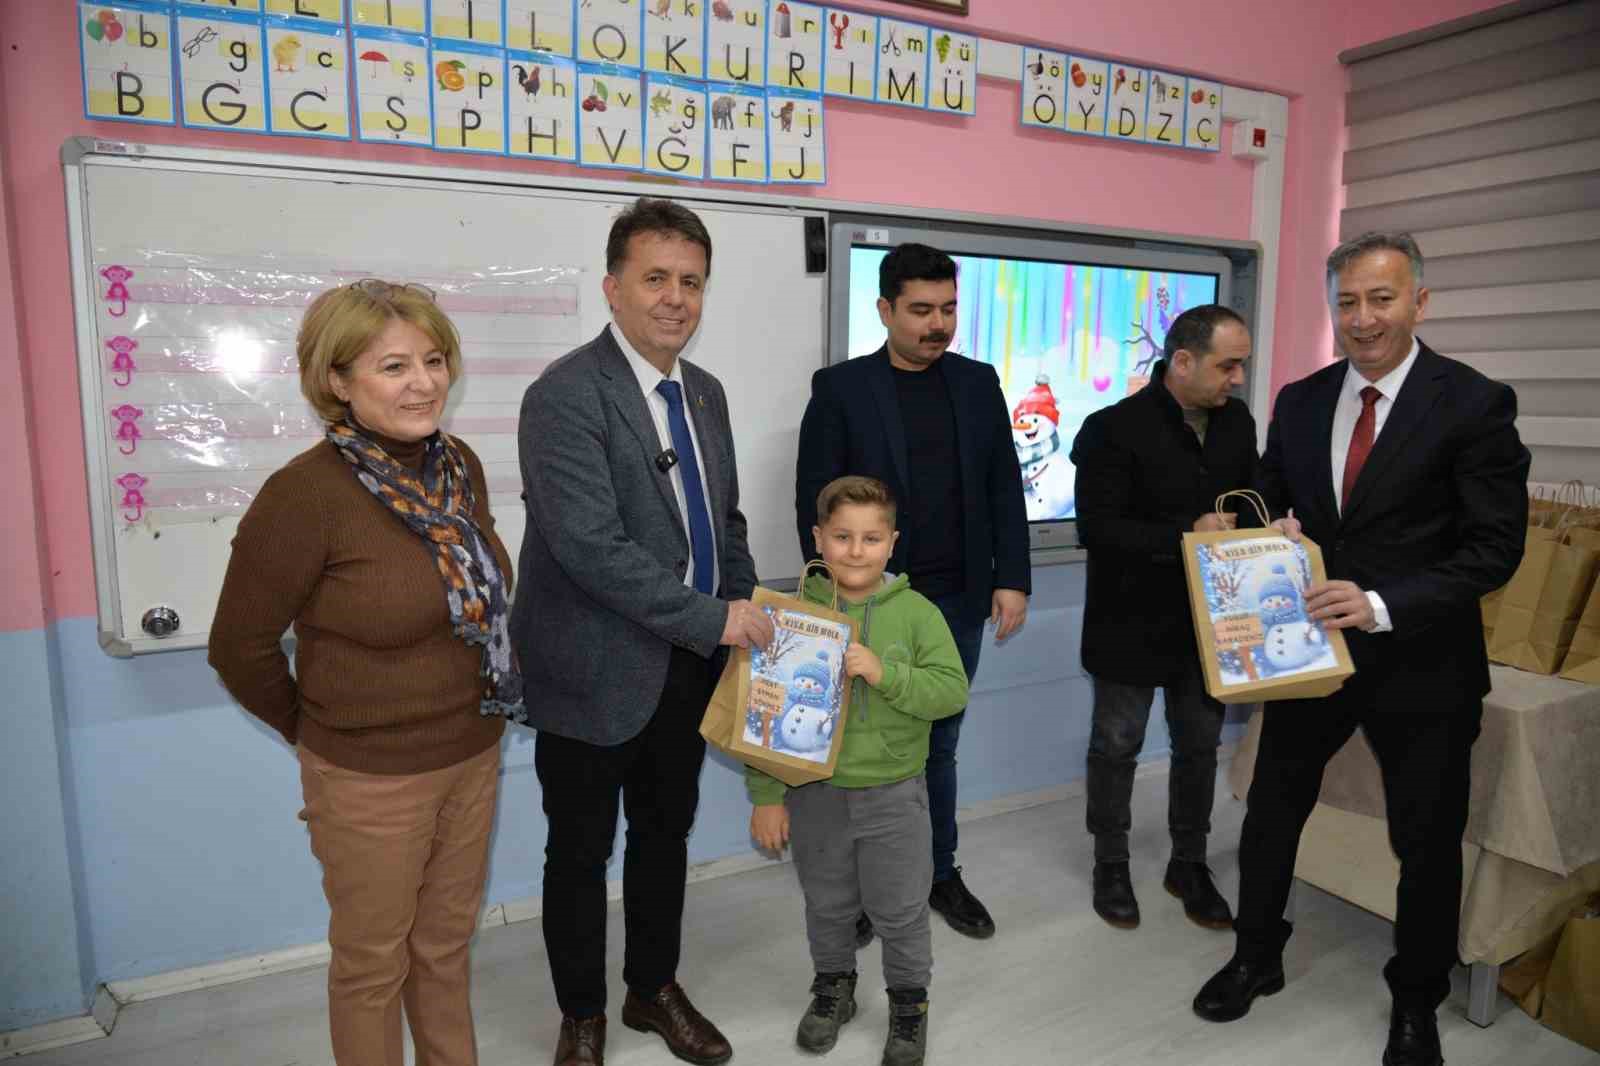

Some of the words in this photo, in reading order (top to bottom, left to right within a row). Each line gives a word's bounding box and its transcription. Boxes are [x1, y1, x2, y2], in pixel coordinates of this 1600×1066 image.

[140, 14, 158, 48] b
[229, 41, 248, 72] g
[318, 52, 333, 68] c
[403, 61, 415, 82] ş
[479, 71, 493, 99] p
[552, 68, 566, 97] h
[618, 92, 631, 107] v
[682, 97, 696, 129] ğ
[744, 102, 756, 128] f
[803, 108, 813, 138] j
[530, 11, 552, 51] L
[593, 24, 627, 61] O
[665, 35, 687, 74] K
[726, 44, 750, 81] U
[789, 51, 806, 87] R
[888, 67, 915, 103] M
[944, 68, 963, 110] Ü
[745, 11, 757, 27] u
[804, 20, 815, 33] r
[907, 37, 923, 53] m
[959, 42, 970, 61] ü
[1033, 85, 1057, 124] Ö
[1078, 101, 1096, 131] Y
[1118, 107, 1137, 137] D
[1156, 112, 1174, 141] Z
[1196, 118, 1212, 148] Ç
[1050, 60, 1060, 77] ö
[1092, 73, 1102, 95] y
[1132, 71, 1142, 93] d
[1170, 87, 1179, 99] z
[117, 72, 145, 116] B
[202, 83, 247, 126] G
[290, 91, 328, 132] C
[386, 96, 408, 140] Ş
[461, 109, 482, 147] P
[528, 116, 557, 155] H
[597, 127, 627, 164] V
[657, 127, 690, 172] Ğ
[732, 143, 750, 177] F
[789, 147, 805, 180] J
